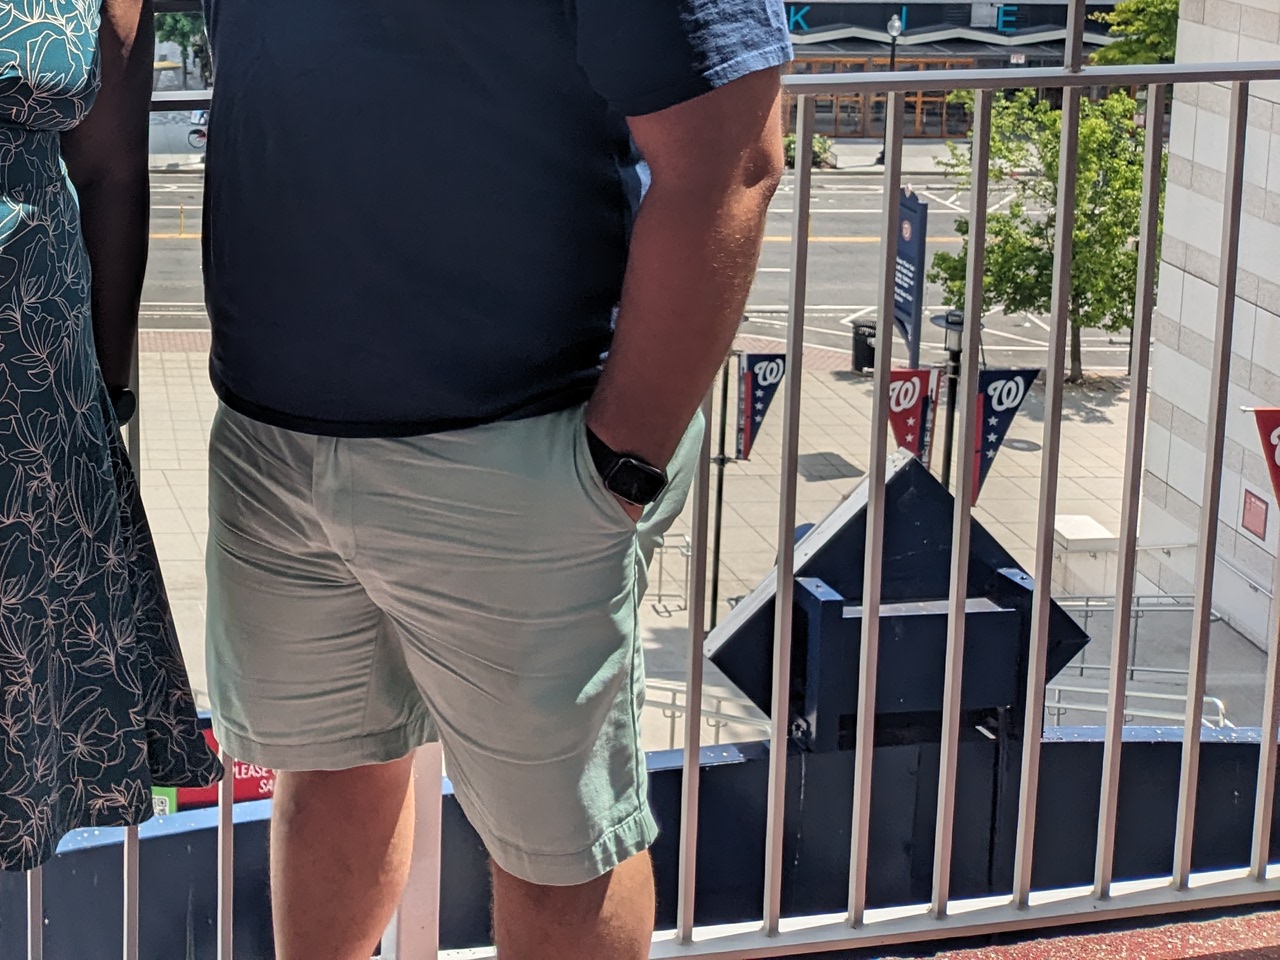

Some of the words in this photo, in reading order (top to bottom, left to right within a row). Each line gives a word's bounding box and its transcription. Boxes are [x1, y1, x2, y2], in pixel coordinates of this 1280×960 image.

[753, 358, 784, 387] W
[889, 376, 921, 413] W
[987, 375, 1025, 412] W
[232, 764, 269, 779] LEASE
